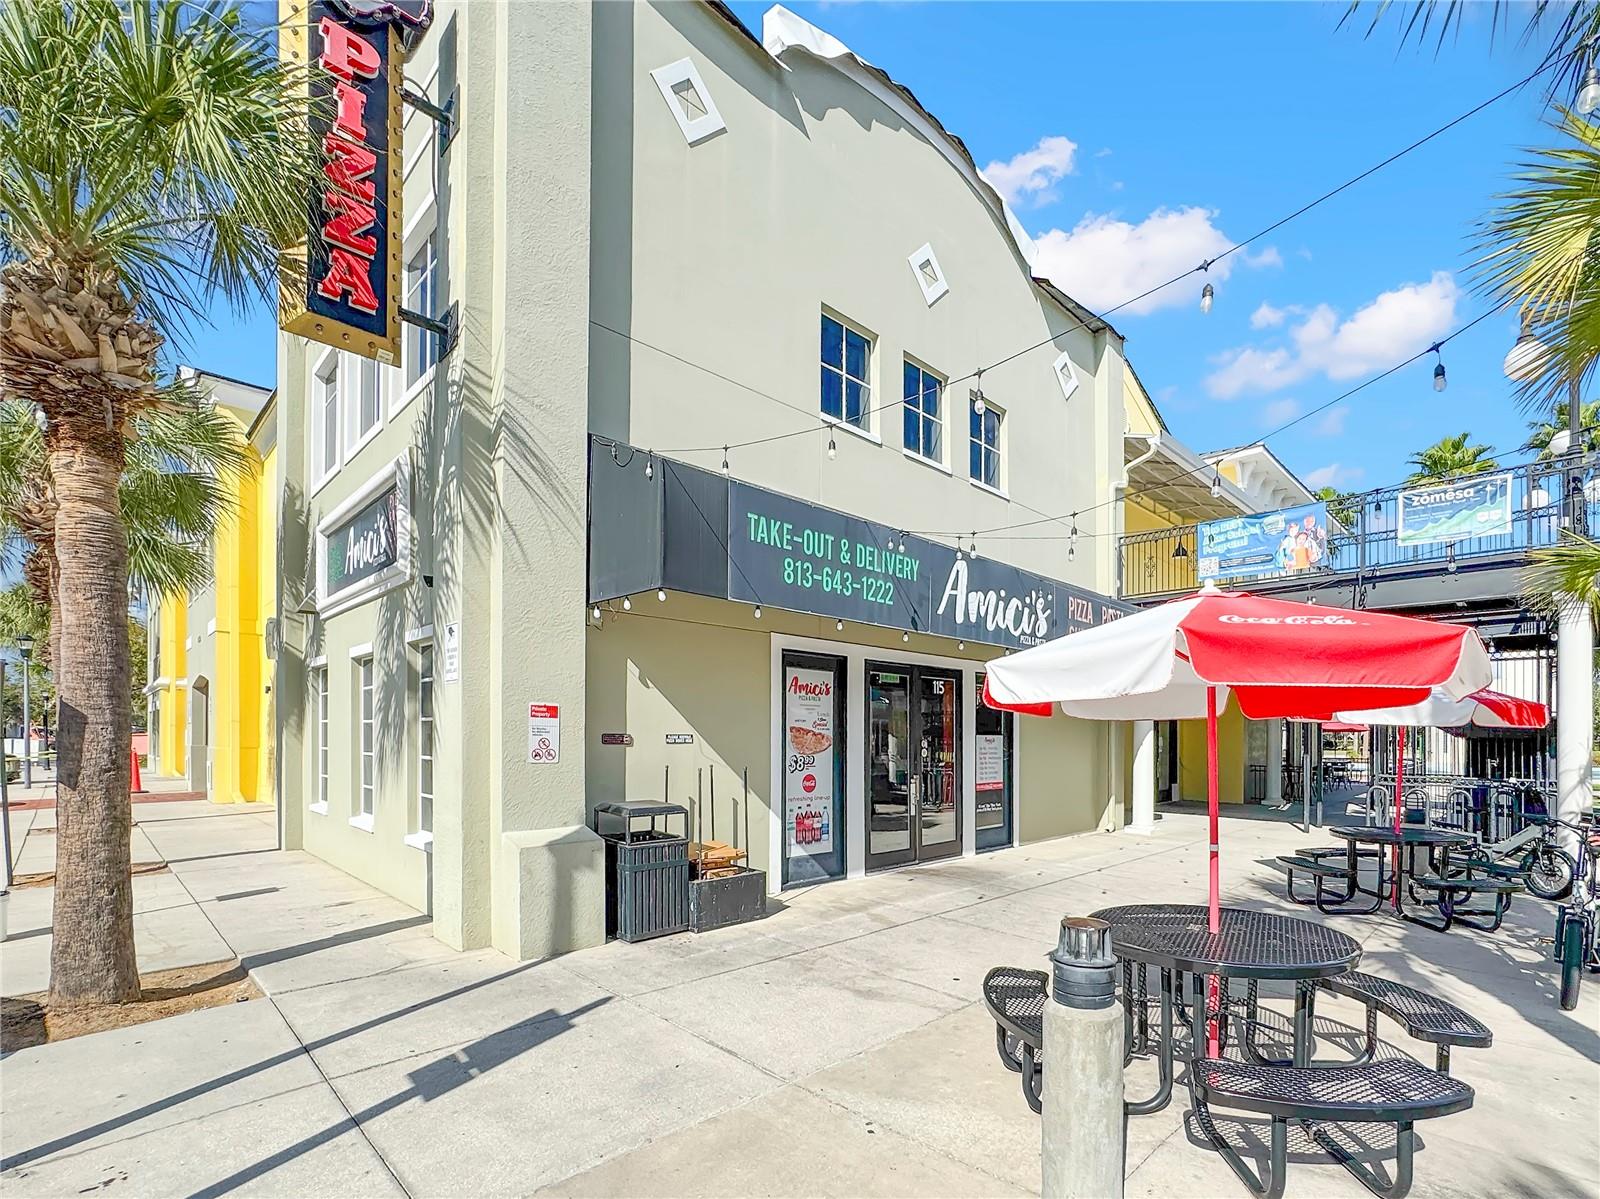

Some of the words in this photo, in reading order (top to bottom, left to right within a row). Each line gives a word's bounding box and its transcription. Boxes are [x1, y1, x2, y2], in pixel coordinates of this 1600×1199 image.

[318, 16, 382, 316] PIZZA
[344, 512, 388, 575] Amici's
[747, 512, 834, 561] TAKE-OUT
[840, 538, 851, 564] &
[856, 543, 920, 582] DELIVERY
[783, 557, 894, 605] 813-643-1222
[936, 559, 1052, 638] Amici's
[1068, 596, 1094, 625] PIZZA
[1218, 614, 1357, 626] Coca-Cola
[788, 676, 831, 697] Amici's
[933, 680, 945, 694] 115
